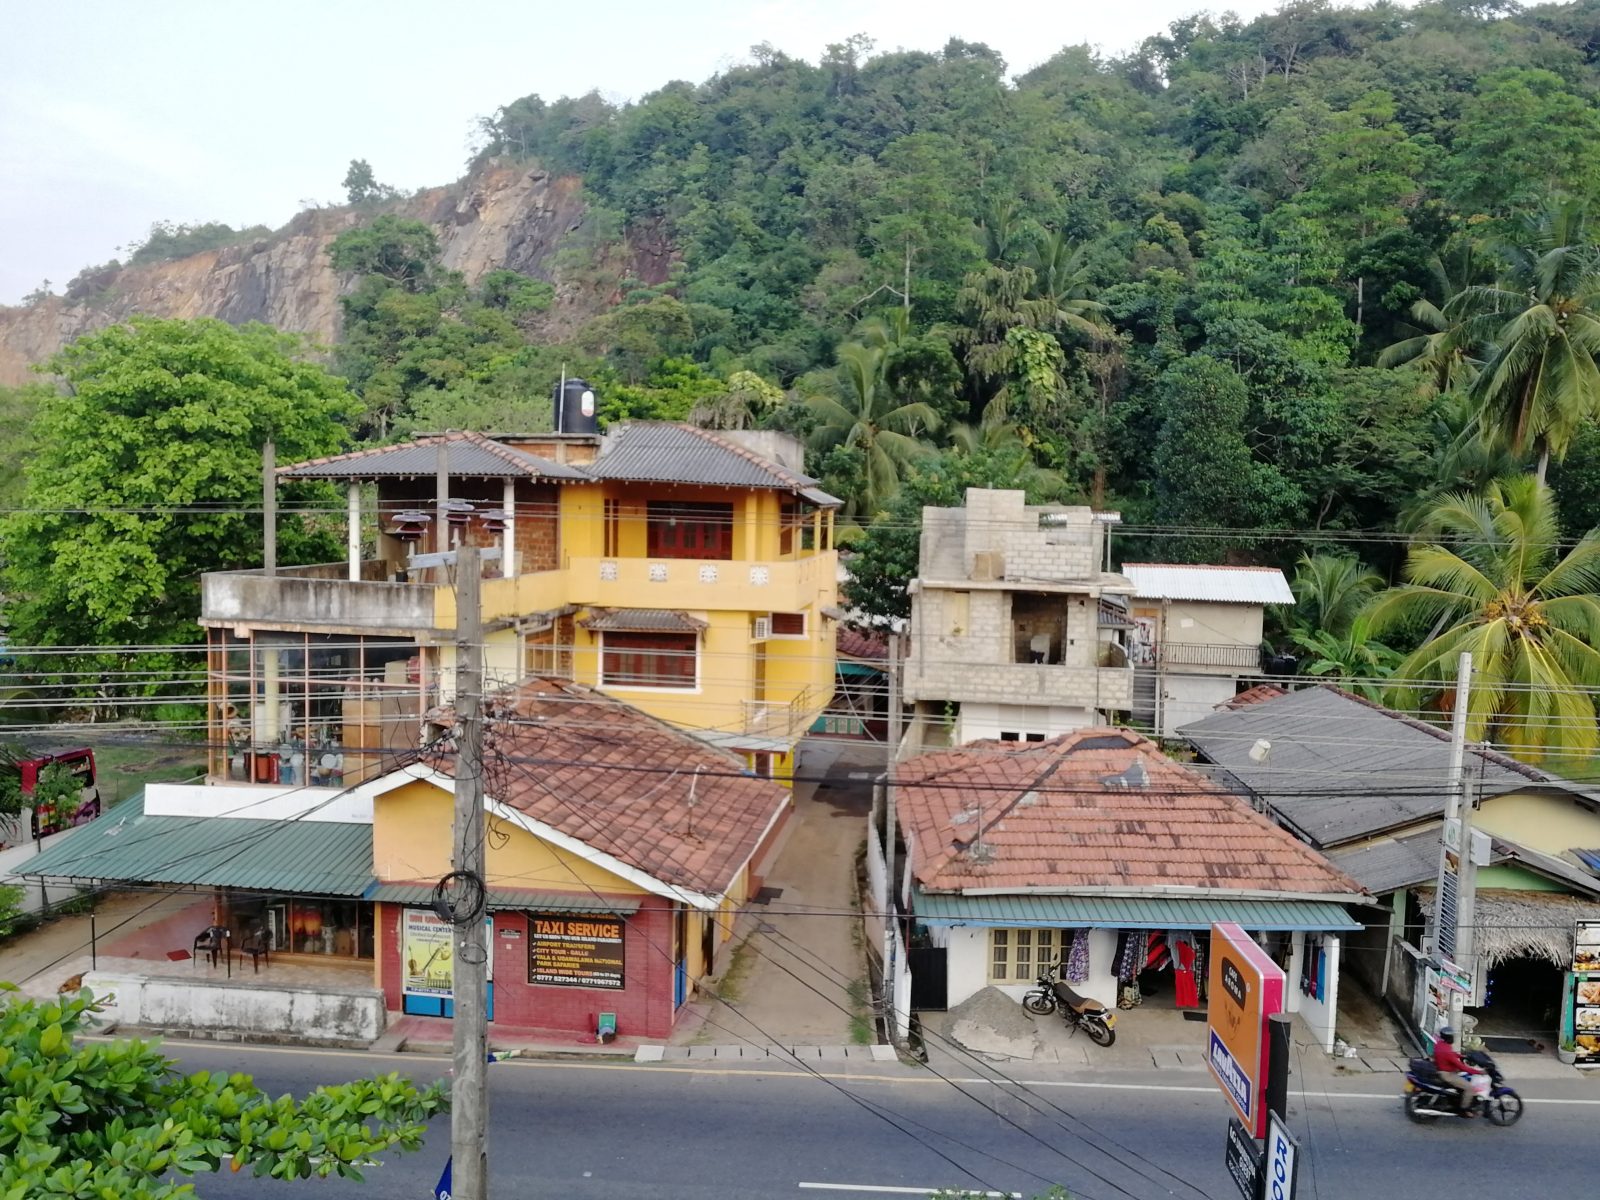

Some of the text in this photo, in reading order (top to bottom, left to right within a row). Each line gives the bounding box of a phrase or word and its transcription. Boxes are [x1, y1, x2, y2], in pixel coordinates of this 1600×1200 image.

[534, 921, 564, 934] TAXI
[567, 923, 619, 938] SERVICE
[562, 942, 596, 950] TRANSFERS
[1224, 974, 1242, 999] AROMA
[1212, 1042, 1247, 1103] LAVAZZA
[1271, 1135, 1288, 1200] ROO
